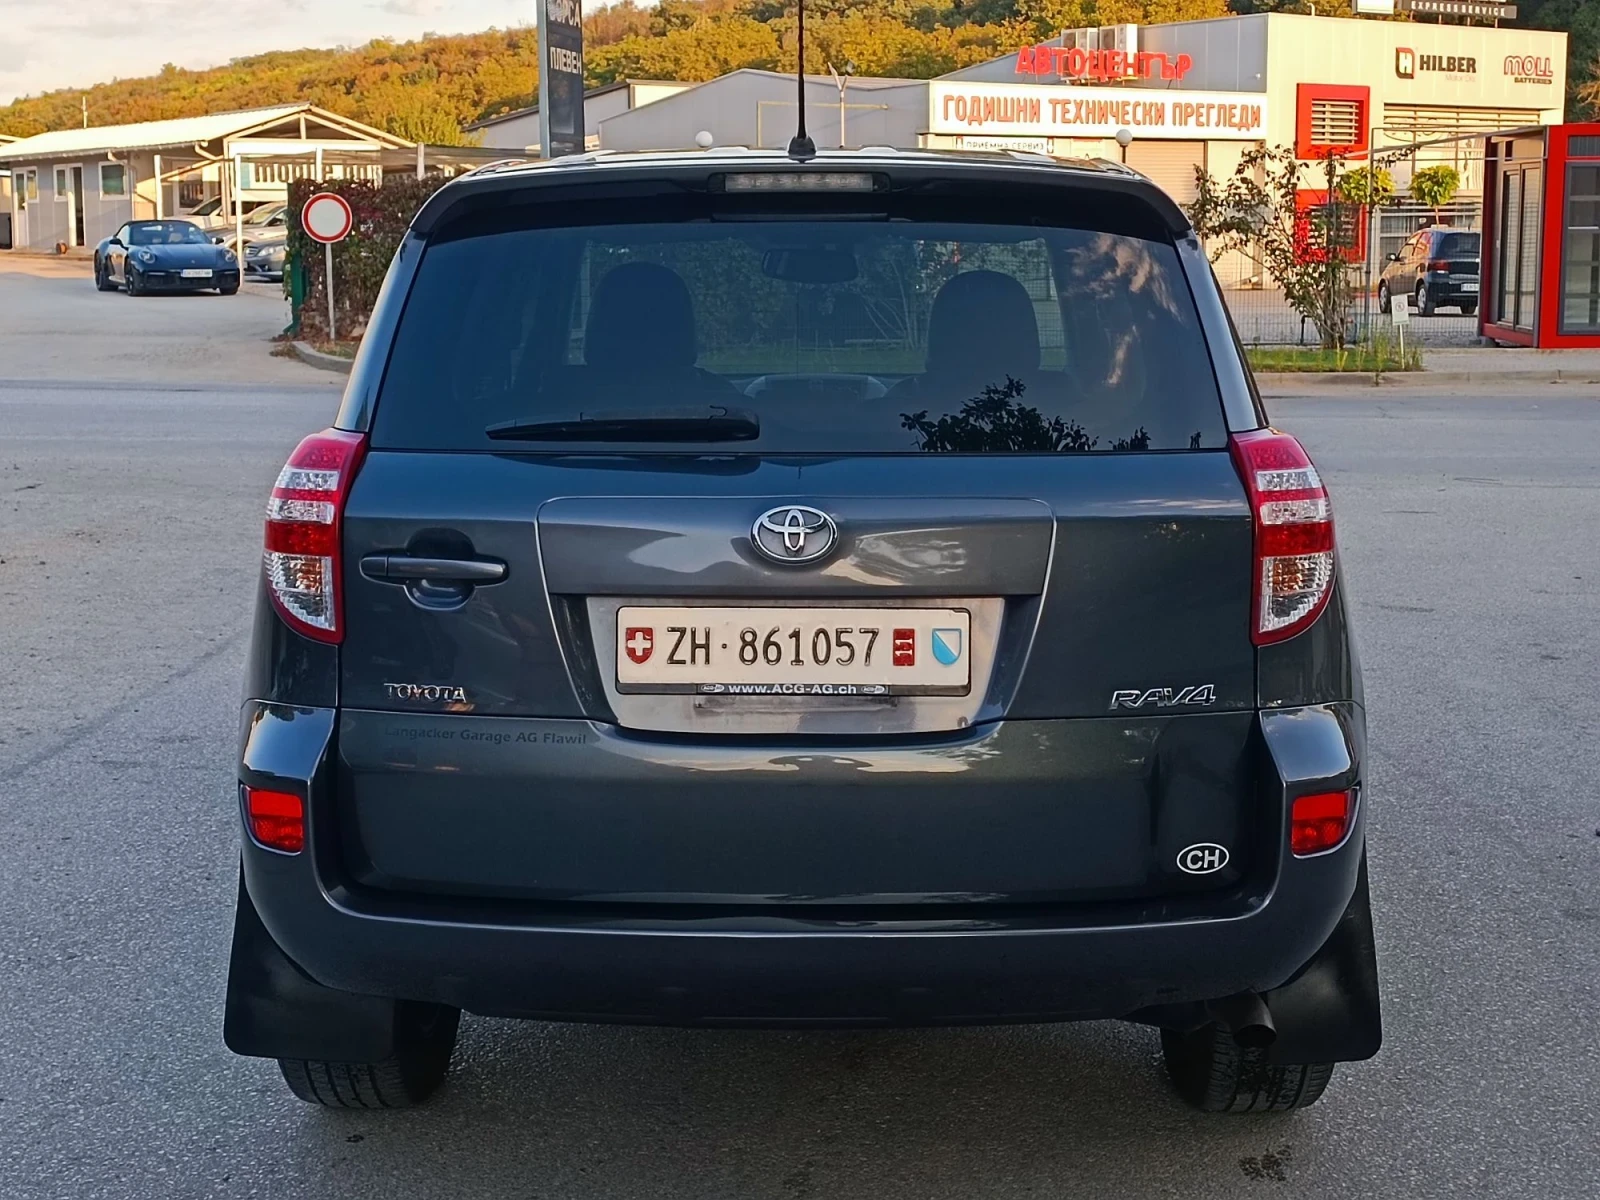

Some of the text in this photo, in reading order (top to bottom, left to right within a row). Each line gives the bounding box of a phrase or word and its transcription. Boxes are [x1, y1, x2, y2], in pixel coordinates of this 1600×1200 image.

[1411, 1, 1506, 17] EXPRESS SERVICE
[550, 46, 582, 74] ПЛЕВЕН
[1015, 45, 1193, 82] АВТОЦЕНТЪР
[1419, 54, 1477, 74] HILBER
[1514, 76, 1552, 85] BATTERIES
[943, 94, 1261, 131] ГОДИШНИ ТЕХНИЧЕСКИ ПРЕГЛЕДИ
[384, 682, 467, 703] TOYOTA
[728, 683, 857, 695] www.ACG-AG.ch
[1109, 684, 1216, 710] RAV4
[385, 726, 587, 745] Langacker Garage AG Flawil
[1186, 849, 1220, 869] CH
